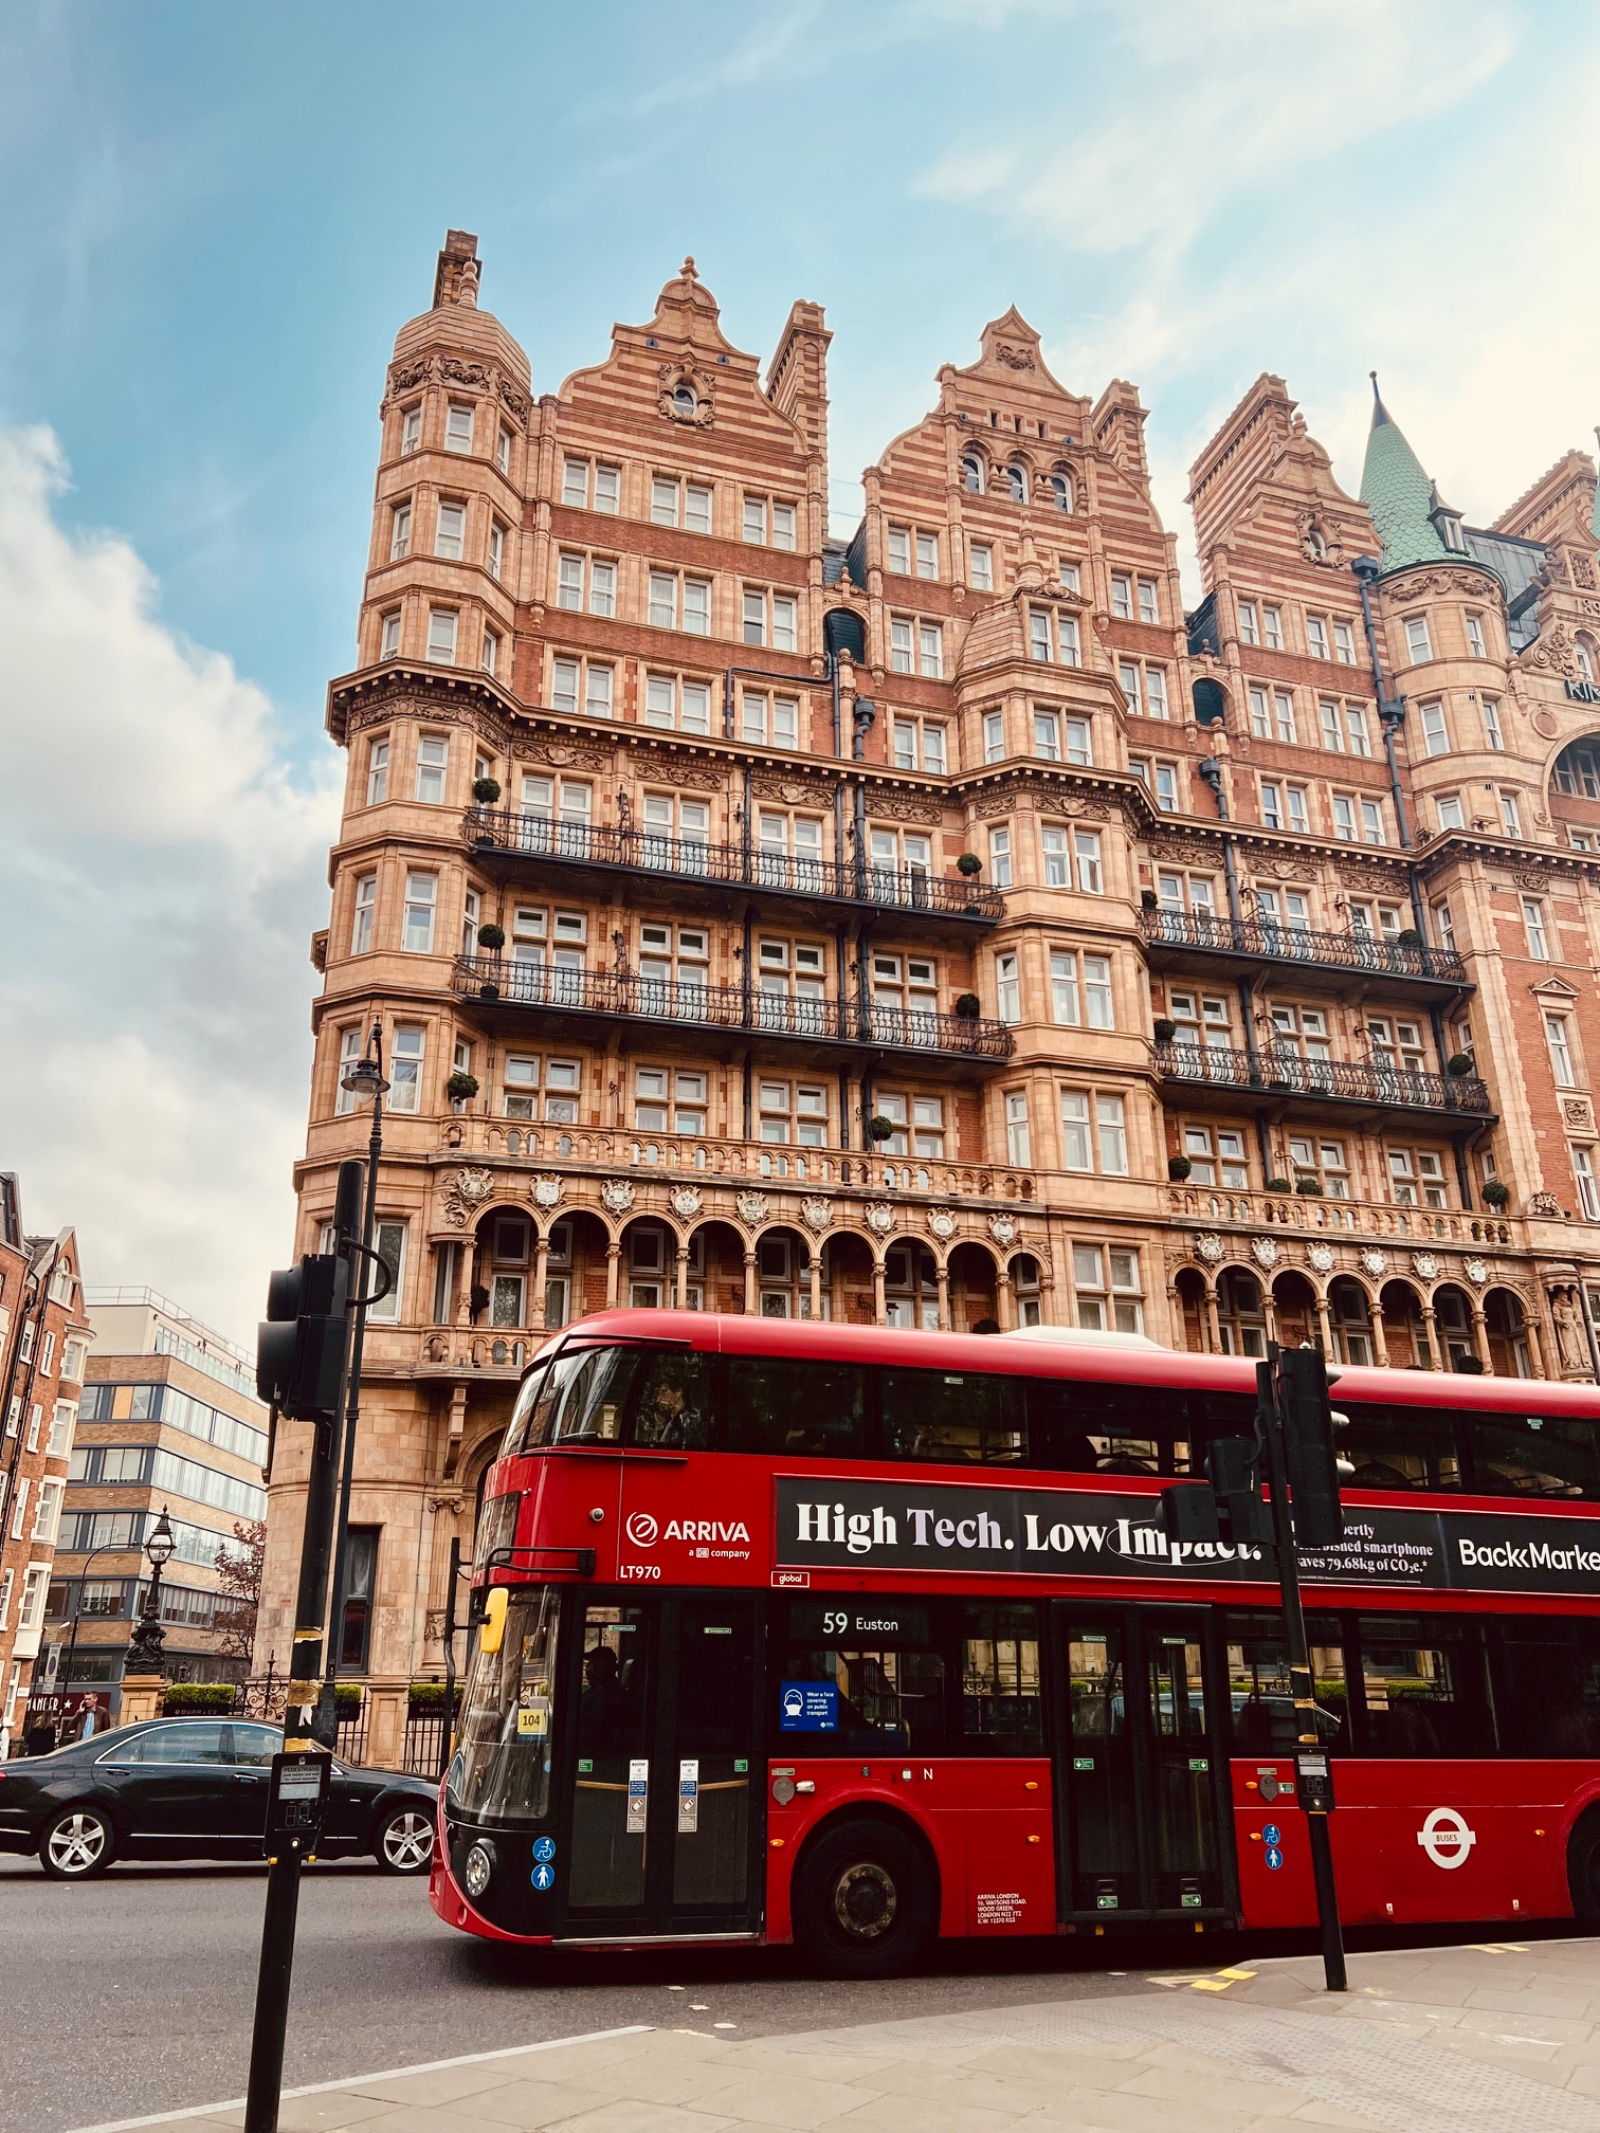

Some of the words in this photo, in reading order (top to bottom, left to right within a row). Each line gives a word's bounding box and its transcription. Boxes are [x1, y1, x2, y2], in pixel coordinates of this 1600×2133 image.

[663, 1520, 750, 1542] ARRIVA
[796, 1503, 898, 1554] High
[906, 1507, 1014, 1550] Tech.
[1023, 1514, 1108, 1552] Low
[1342, 1524, 1375, 1539] ertly
[688, 1549, 694, 1557] a
[696, 1548, 709, 1558] DB
[711, 1549, 750, 1560] company
[1364, 1542, 1434, 1557] smartphone
[620, 1565, 661, 1579] LT970
[1327, 1557, 1376, 1573] 79.68kg
[1376, 1558, 1389, 1571] of
[779, 1573, 802, 1584] global
[822, 1612, 848, 1634] 59
[856, 1617, 899, 1631] Euston
[522, 1715, 540, 1726] 104
[923, 1768, 933, 1780] N
[1436, 1834, 1457, 1842] BUSES
